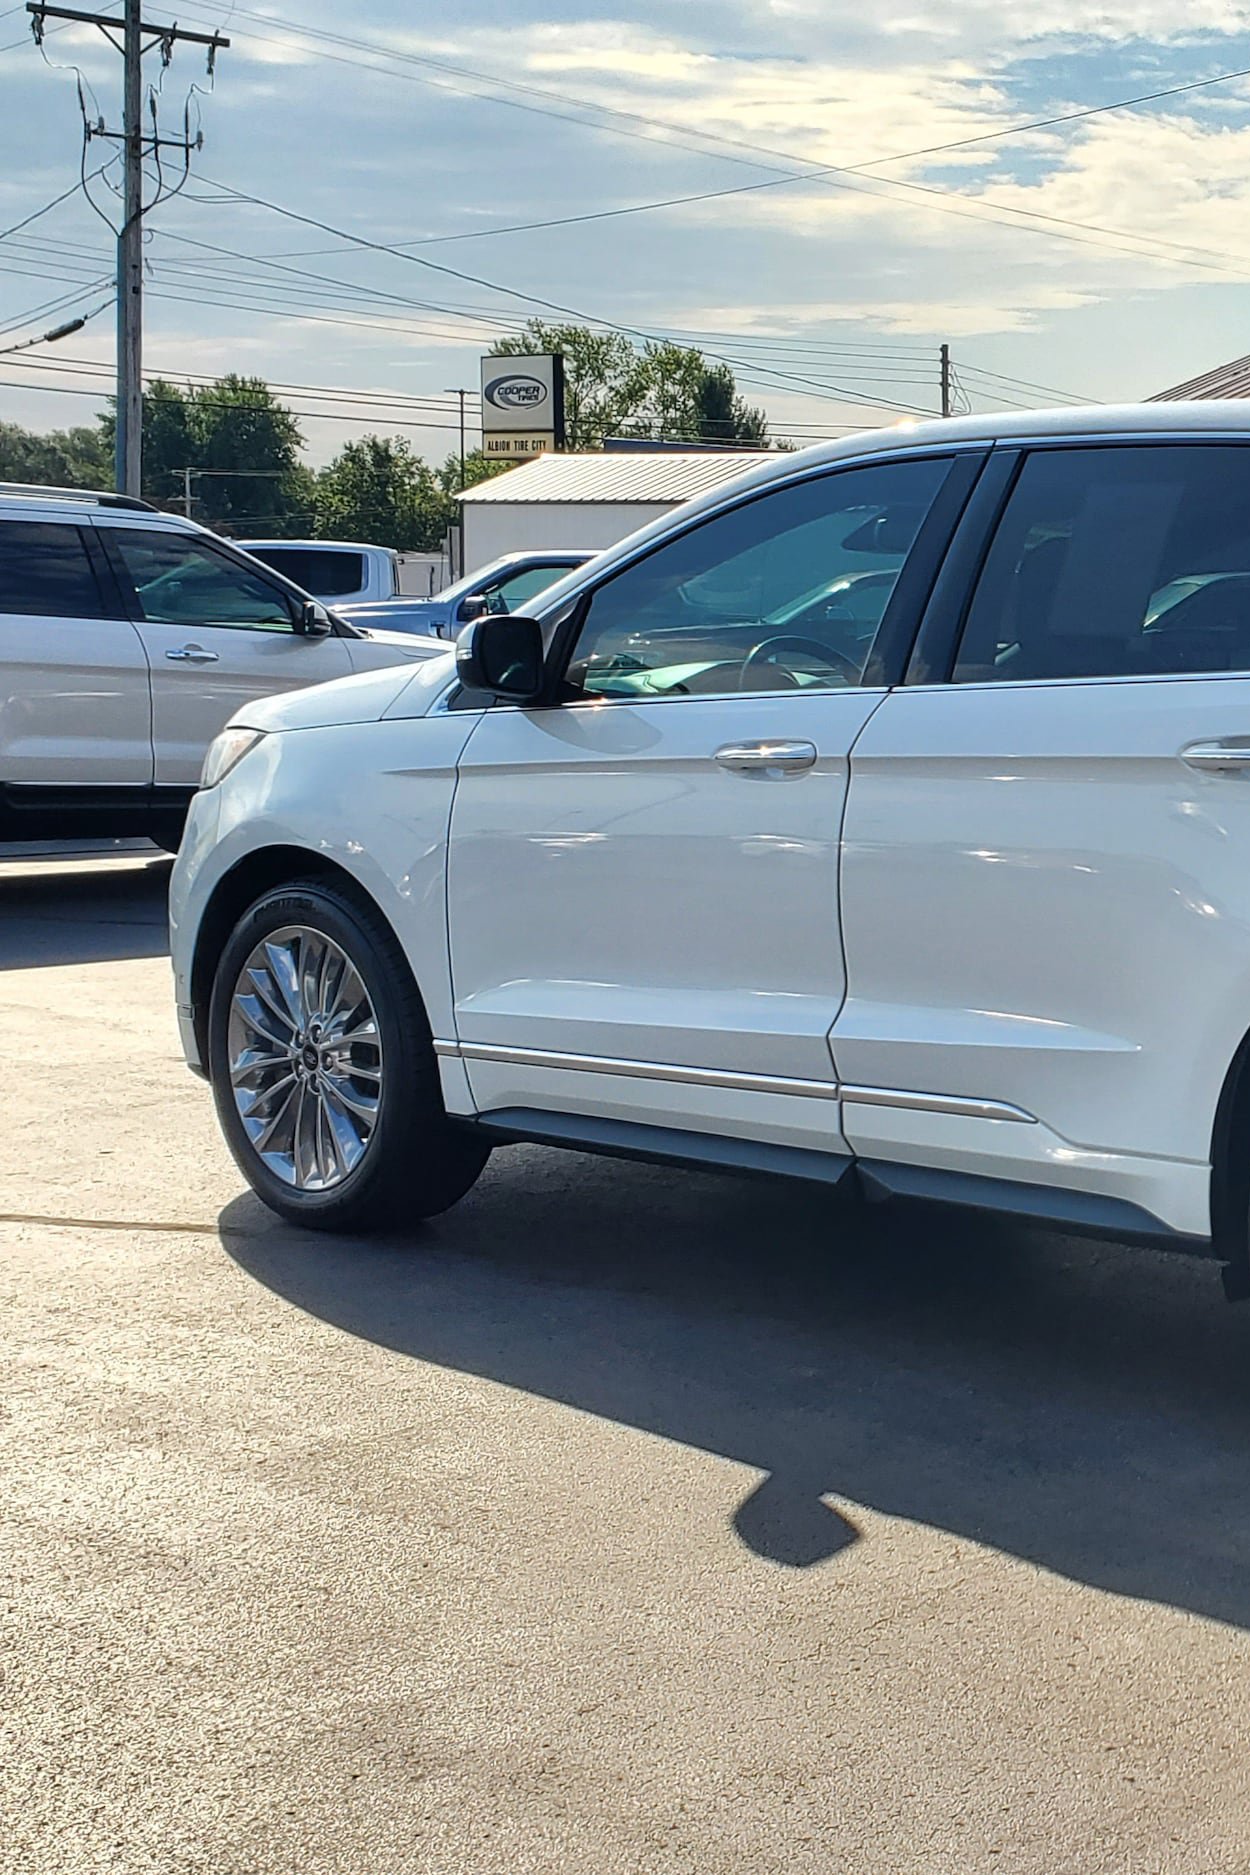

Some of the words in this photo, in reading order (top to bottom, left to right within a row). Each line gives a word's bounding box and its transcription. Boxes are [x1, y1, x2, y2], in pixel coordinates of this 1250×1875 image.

[497, 386, 540, 395] COOPER
[488, 440, 510, 451] ALBION
[514, 440, 528, 451] TIRE
[532, 440, 546, 451] CITY
